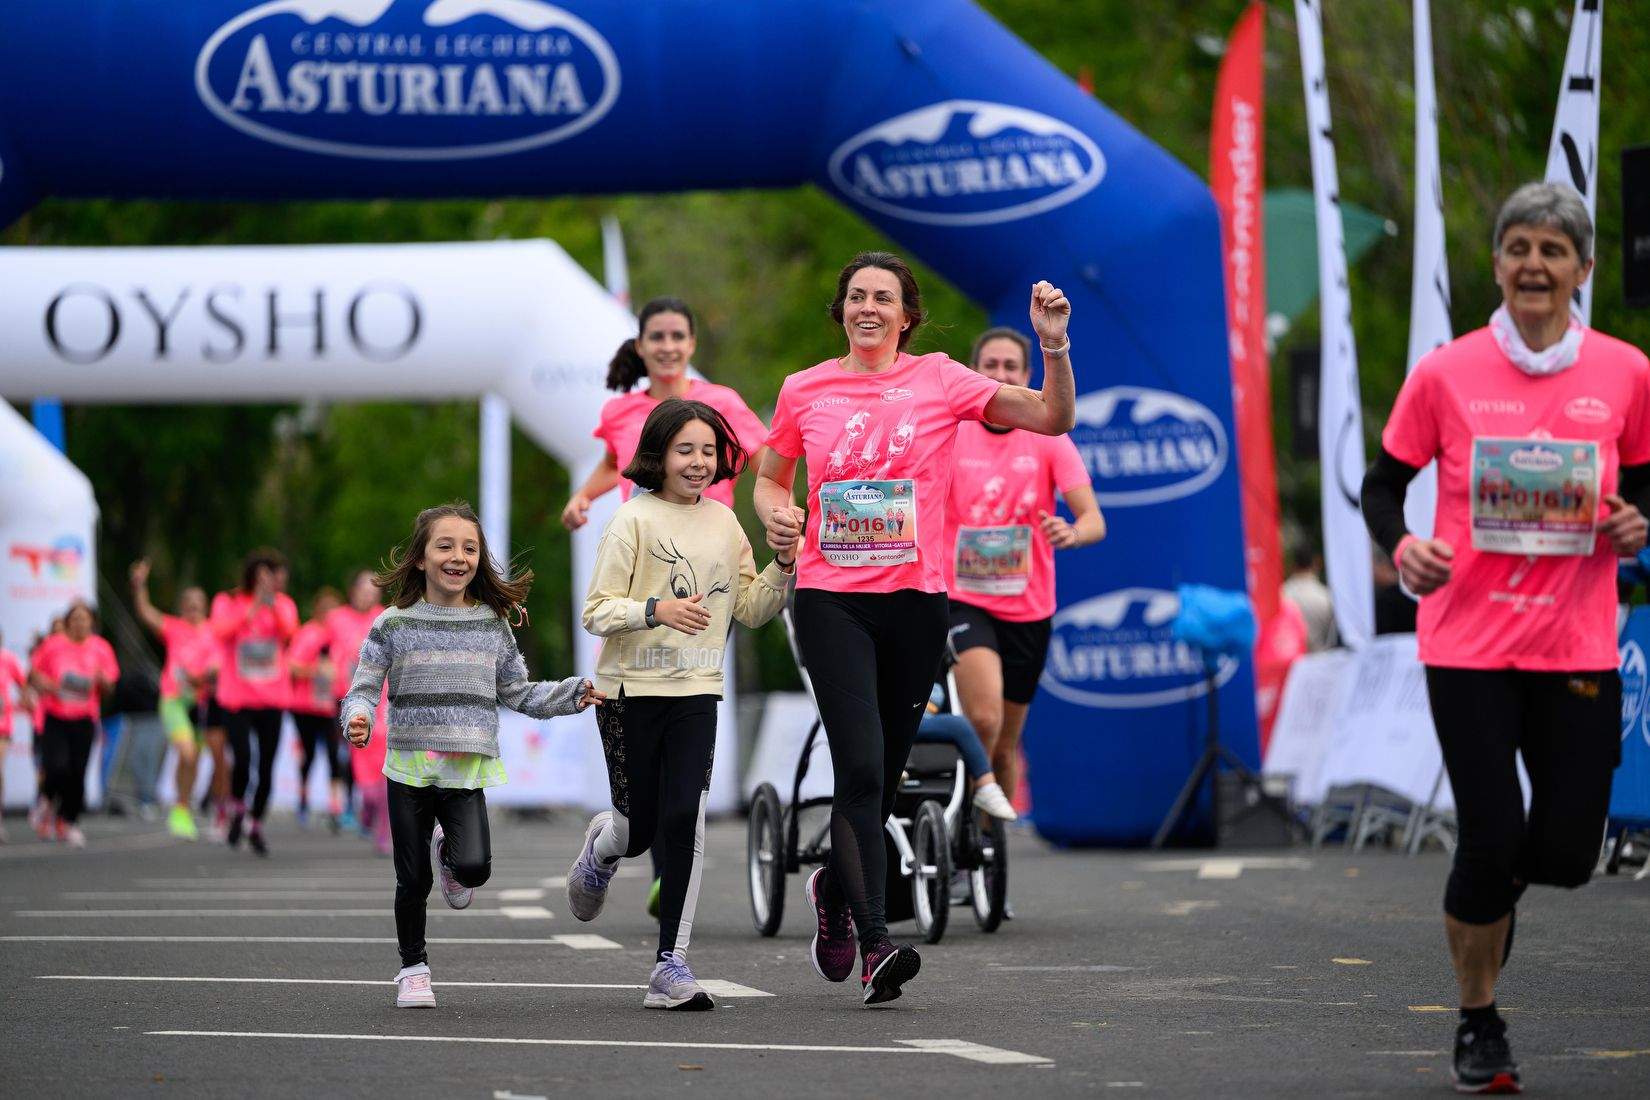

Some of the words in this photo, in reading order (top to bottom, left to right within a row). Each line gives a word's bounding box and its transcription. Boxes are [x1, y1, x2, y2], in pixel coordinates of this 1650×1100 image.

[291, 32, 426, 56] CENTRAL
[434, 33, 573, 57] LECHERA
[231, 34, 588, 116] ASTURIANA
[853, 151, 1084, 197] ASTURIANA
[44, 281, 423, 364] OYSHO
[812, 397, 850, 410] OYSHO
[845, 492, 883, 501] ASTURIANA
[848, 517, 885, 532] 016
[857, 535, 875, 543] 1235
[830, 553, 859, 561] OYSHO
[877, 553, 906, 561] Santander
[635, 647, 672, 669] LIFE
